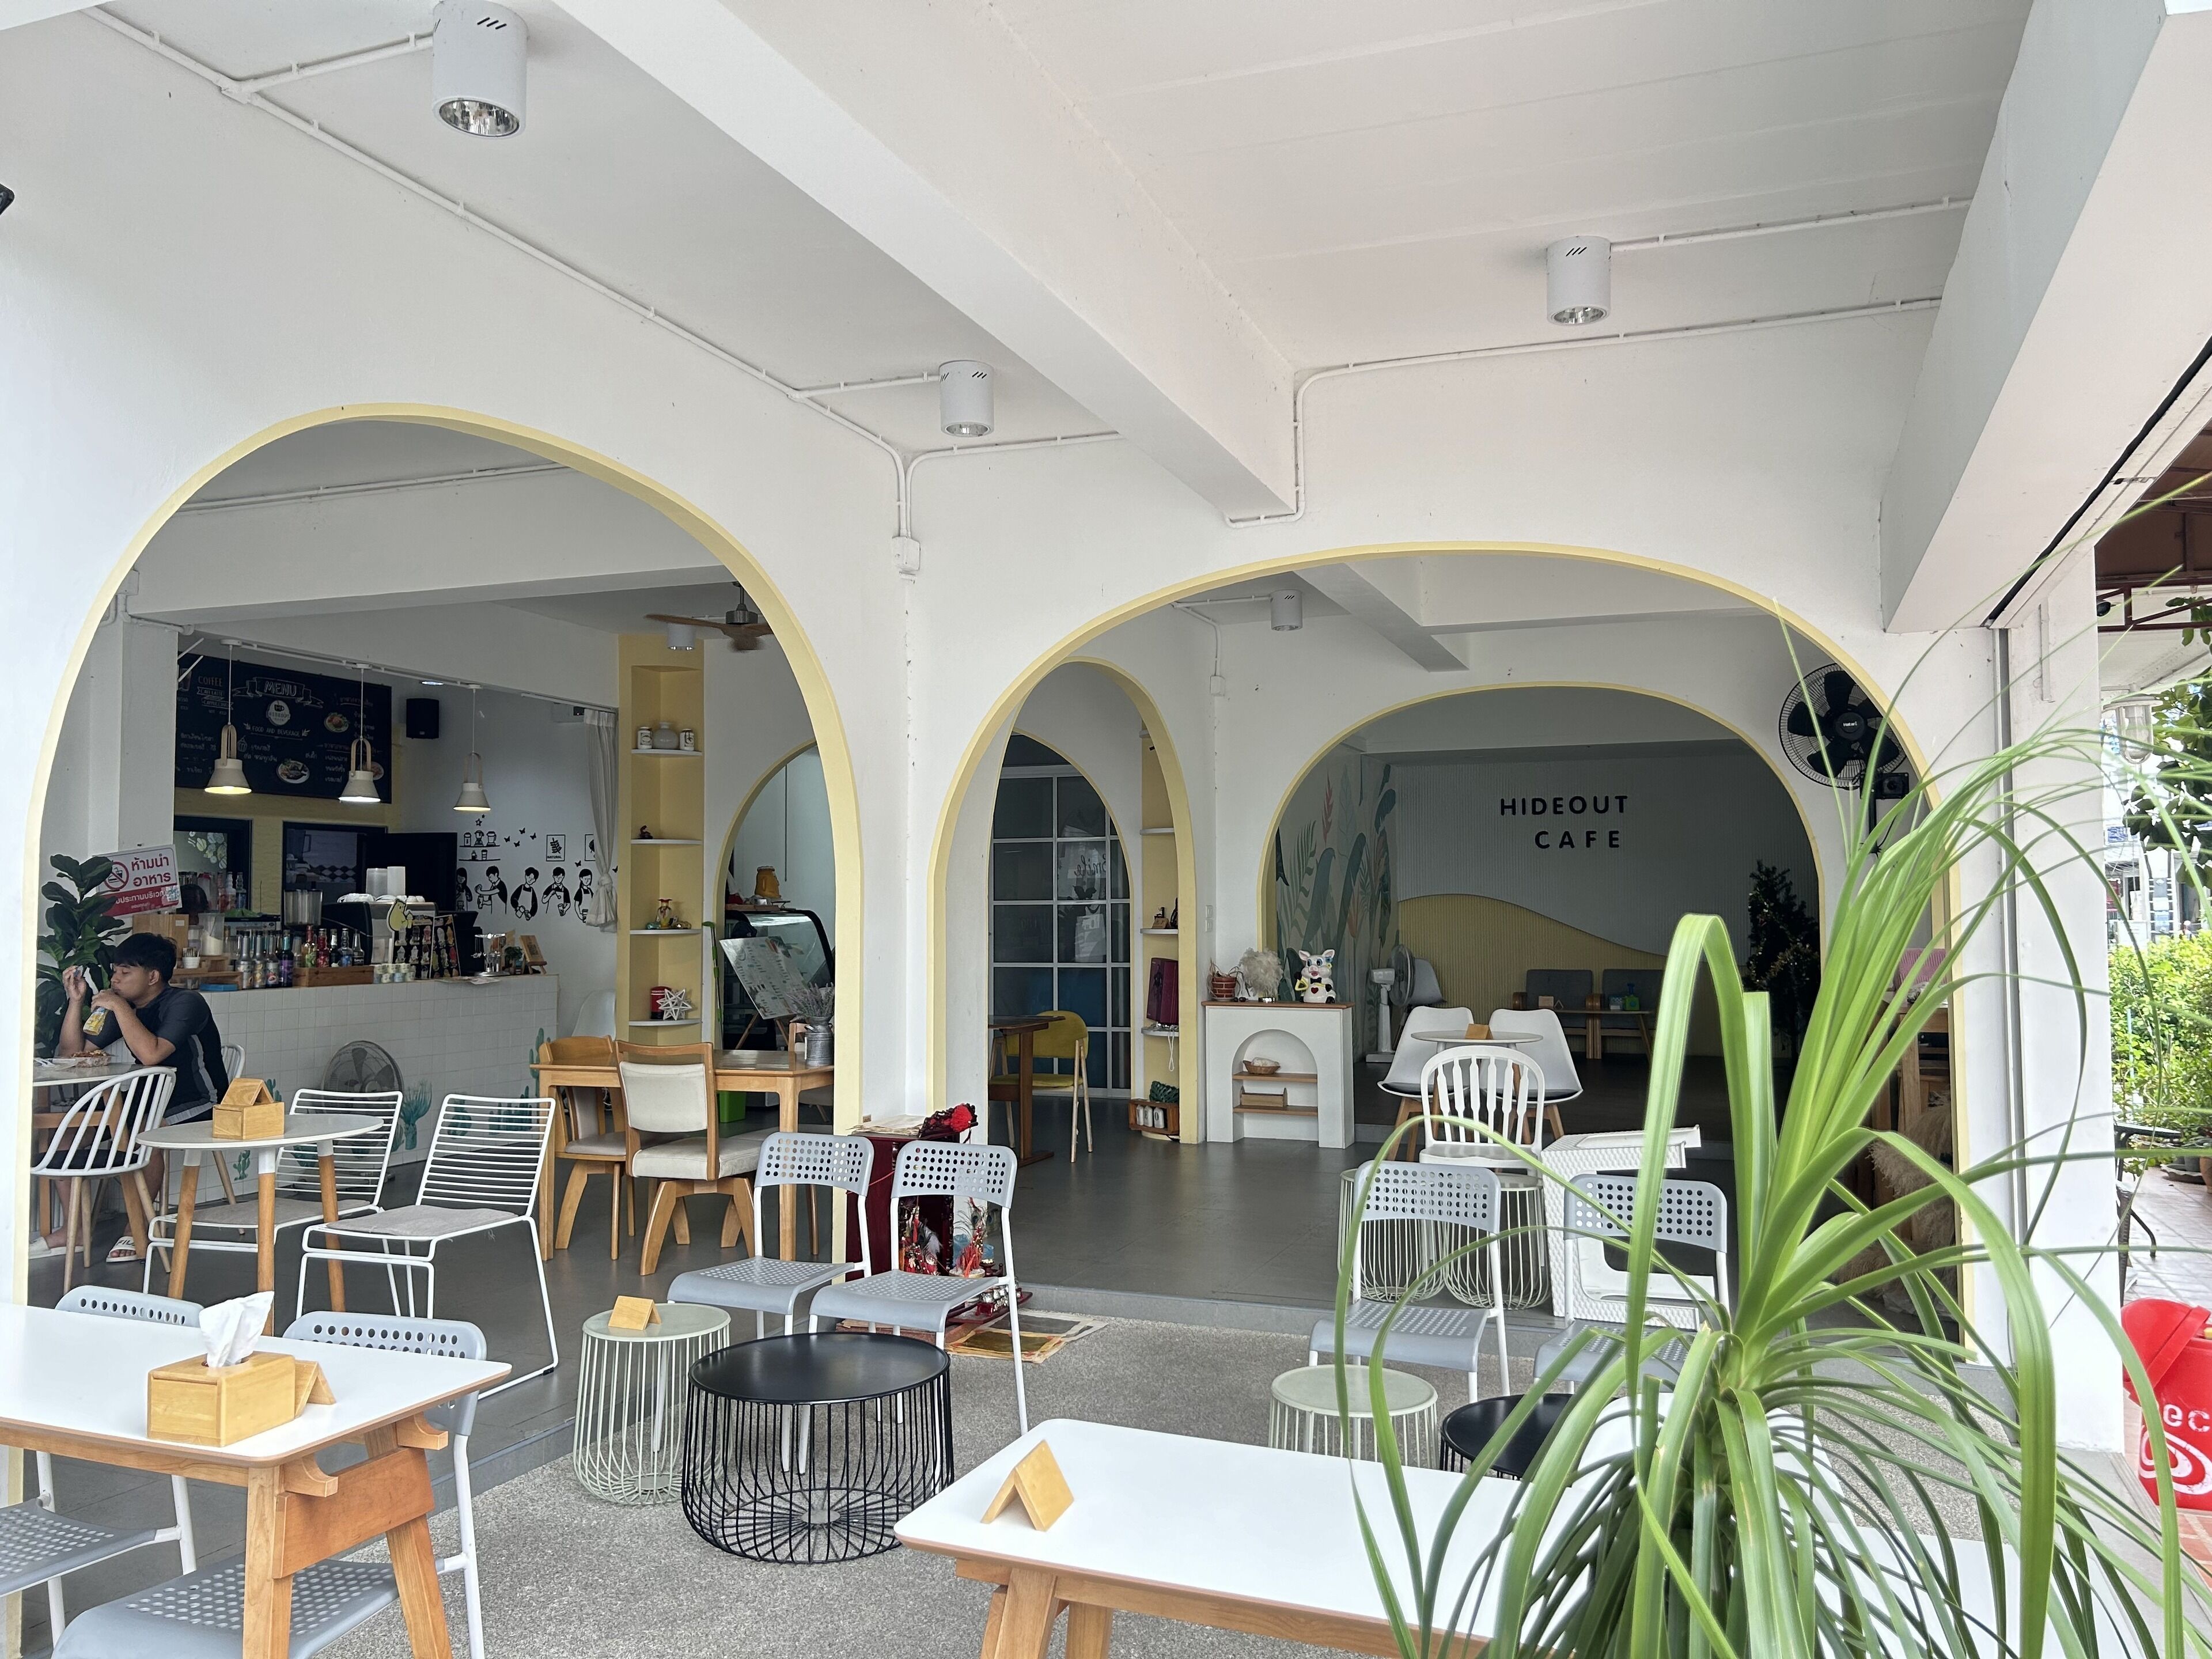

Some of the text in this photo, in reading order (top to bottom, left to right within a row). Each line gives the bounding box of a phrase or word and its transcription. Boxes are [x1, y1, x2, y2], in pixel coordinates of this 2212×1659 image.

[198, 676, 222, 687] COFFEE
[264, 680, 297, 696] MENU
[277, 728, 301, 737] BEVERAGE
[1500, 796, 1628, 816] HIDEOUT
[1535, 830, 1620, 849] CAFE
[131, 854, 170, 871] ห้ามนำ
[133, 872, 171, 887] อาหาร
